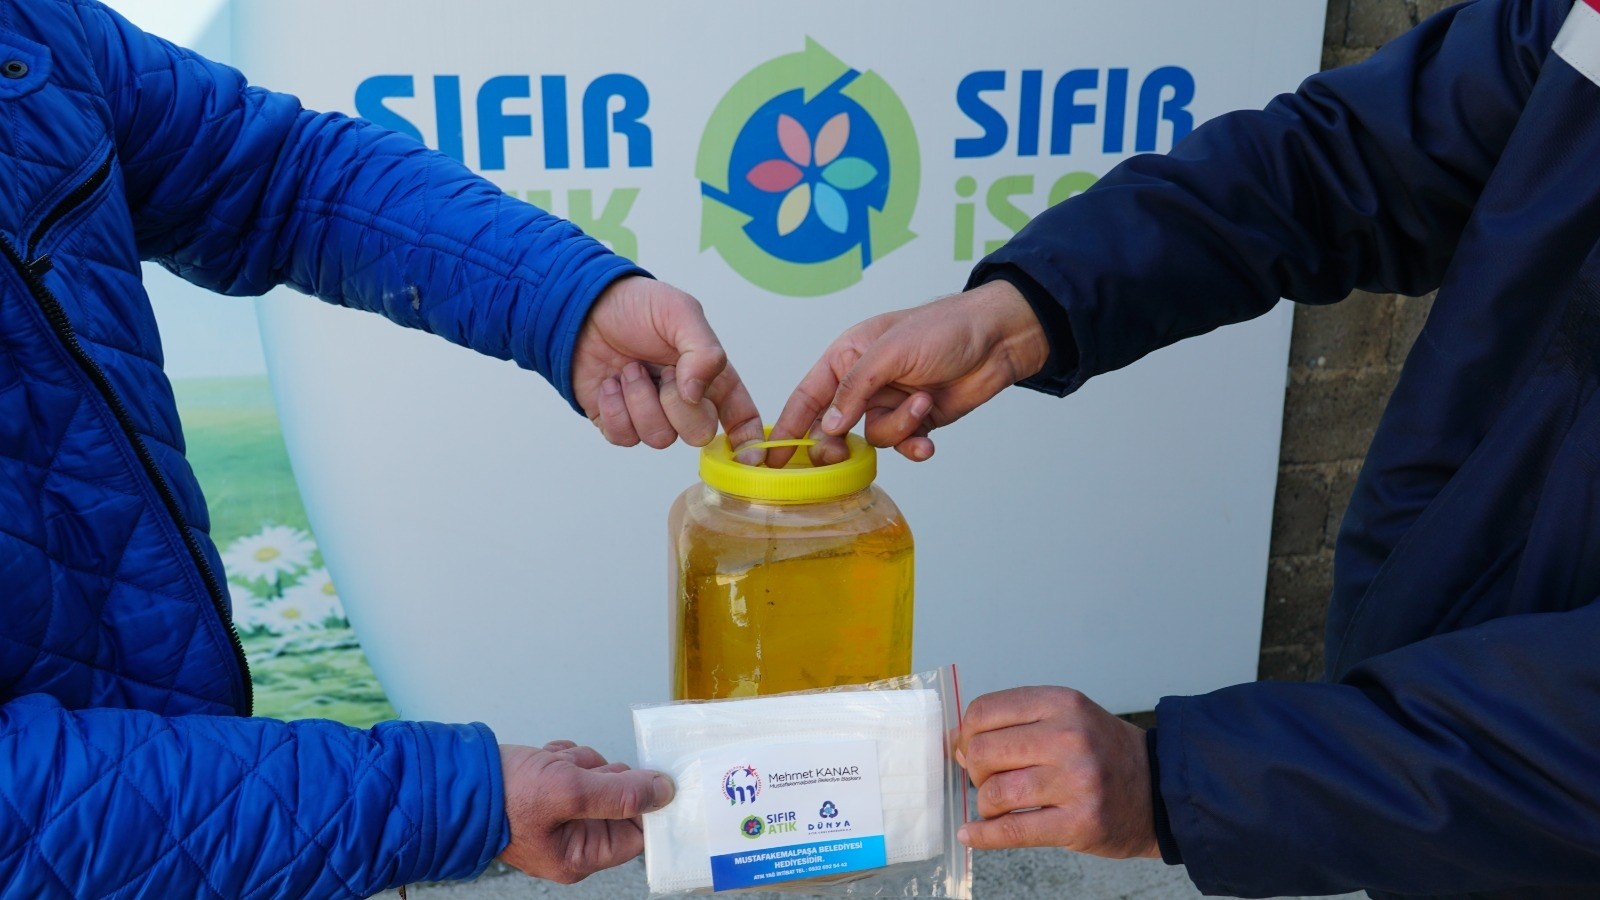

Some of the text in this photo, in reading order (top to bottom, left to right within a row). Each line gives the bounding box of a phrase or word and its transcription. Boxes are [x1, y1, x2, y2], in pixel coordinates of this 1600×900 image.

[954, 65, 1195, 159] SIFIR
[354, 73, 653, 170] SIFIR
[769, 766, 859, 784] Mehmet KANAR
[766, 811, 796, 824] SIFIR
[808, 820, 851, 831] DÜNYA
[768, 821, 797, 835] ATIK
[734, 841, 863, 865] MUSTAFAKEMALPAŞA BELEDİYESİ
[774, 856, 825, 869] HEDİYESİDİR.
